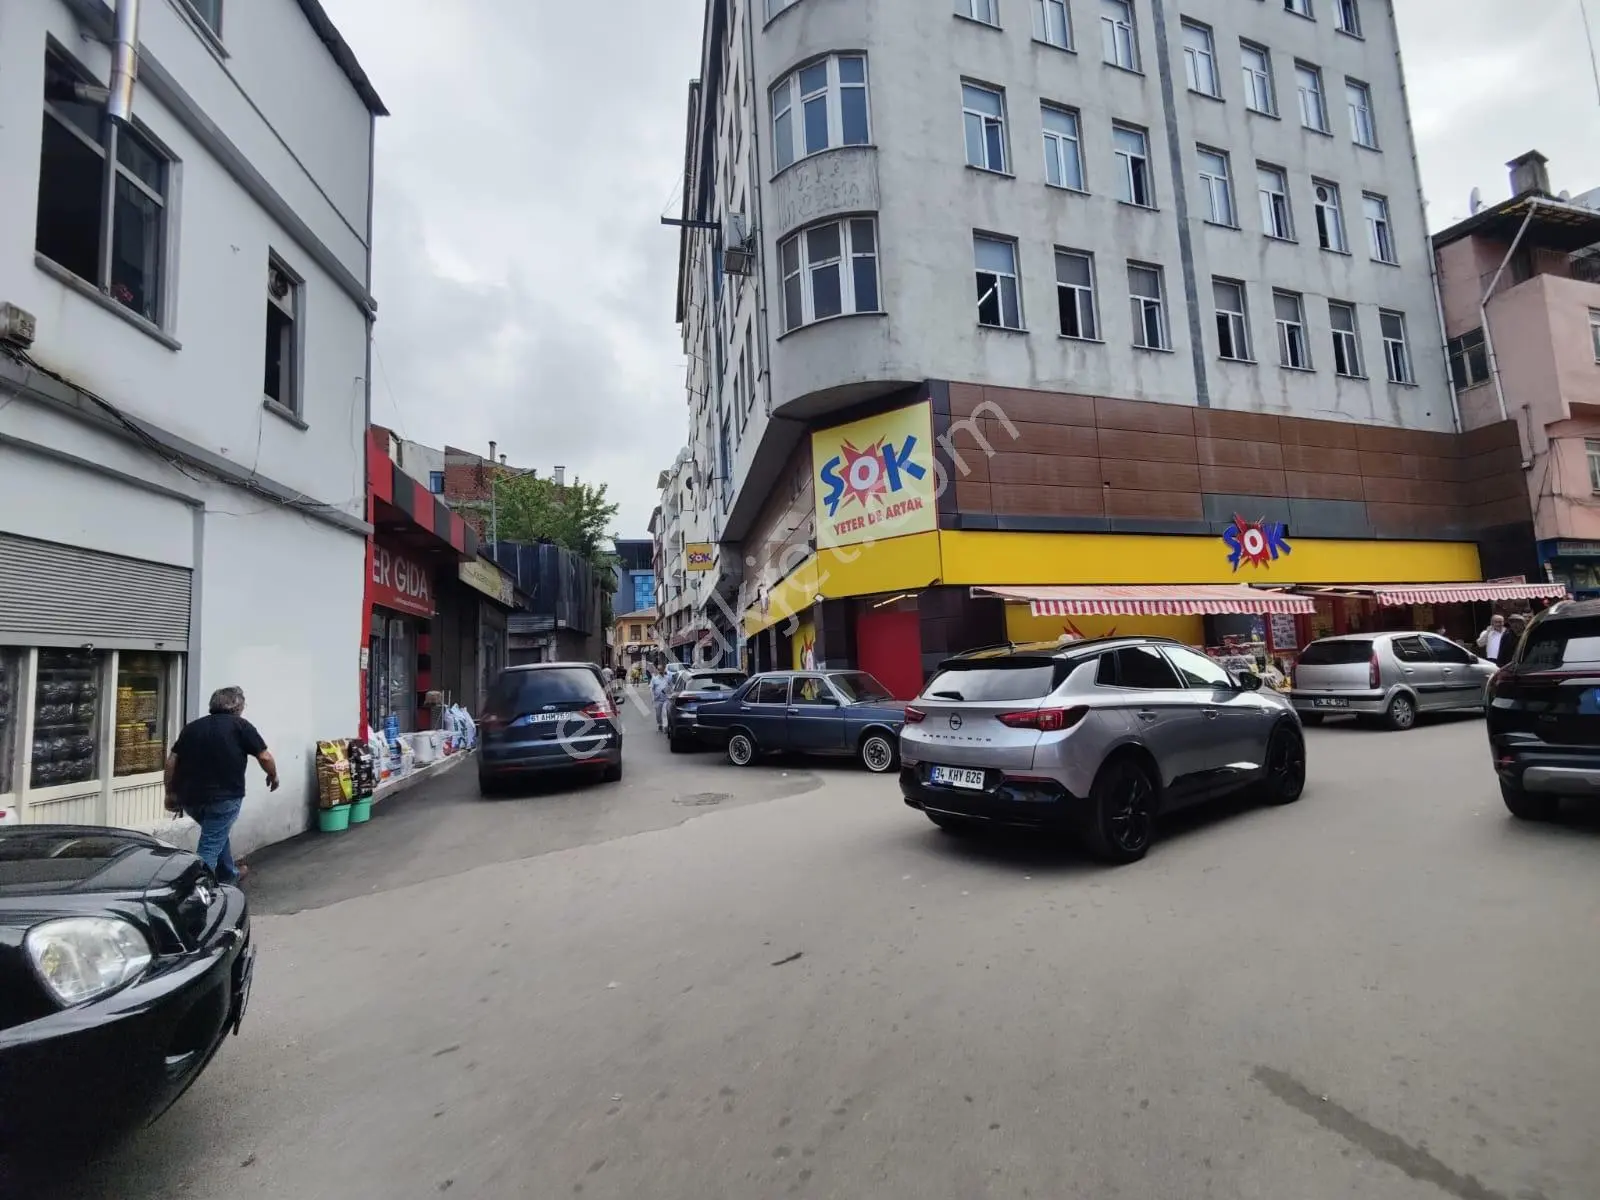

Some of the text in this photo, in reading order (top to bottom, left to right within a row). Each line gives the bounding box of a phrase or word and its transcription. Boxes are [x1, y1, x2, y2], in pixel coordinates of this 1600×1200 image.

[820, 434, 927, 518] ŞOK
[833, 515, 866, 537] YETER
[867, 510, 883, 524] DE
[394, 554, 429, 603] GIDA
[935, 767, 982, 785] 34 KHY 826
